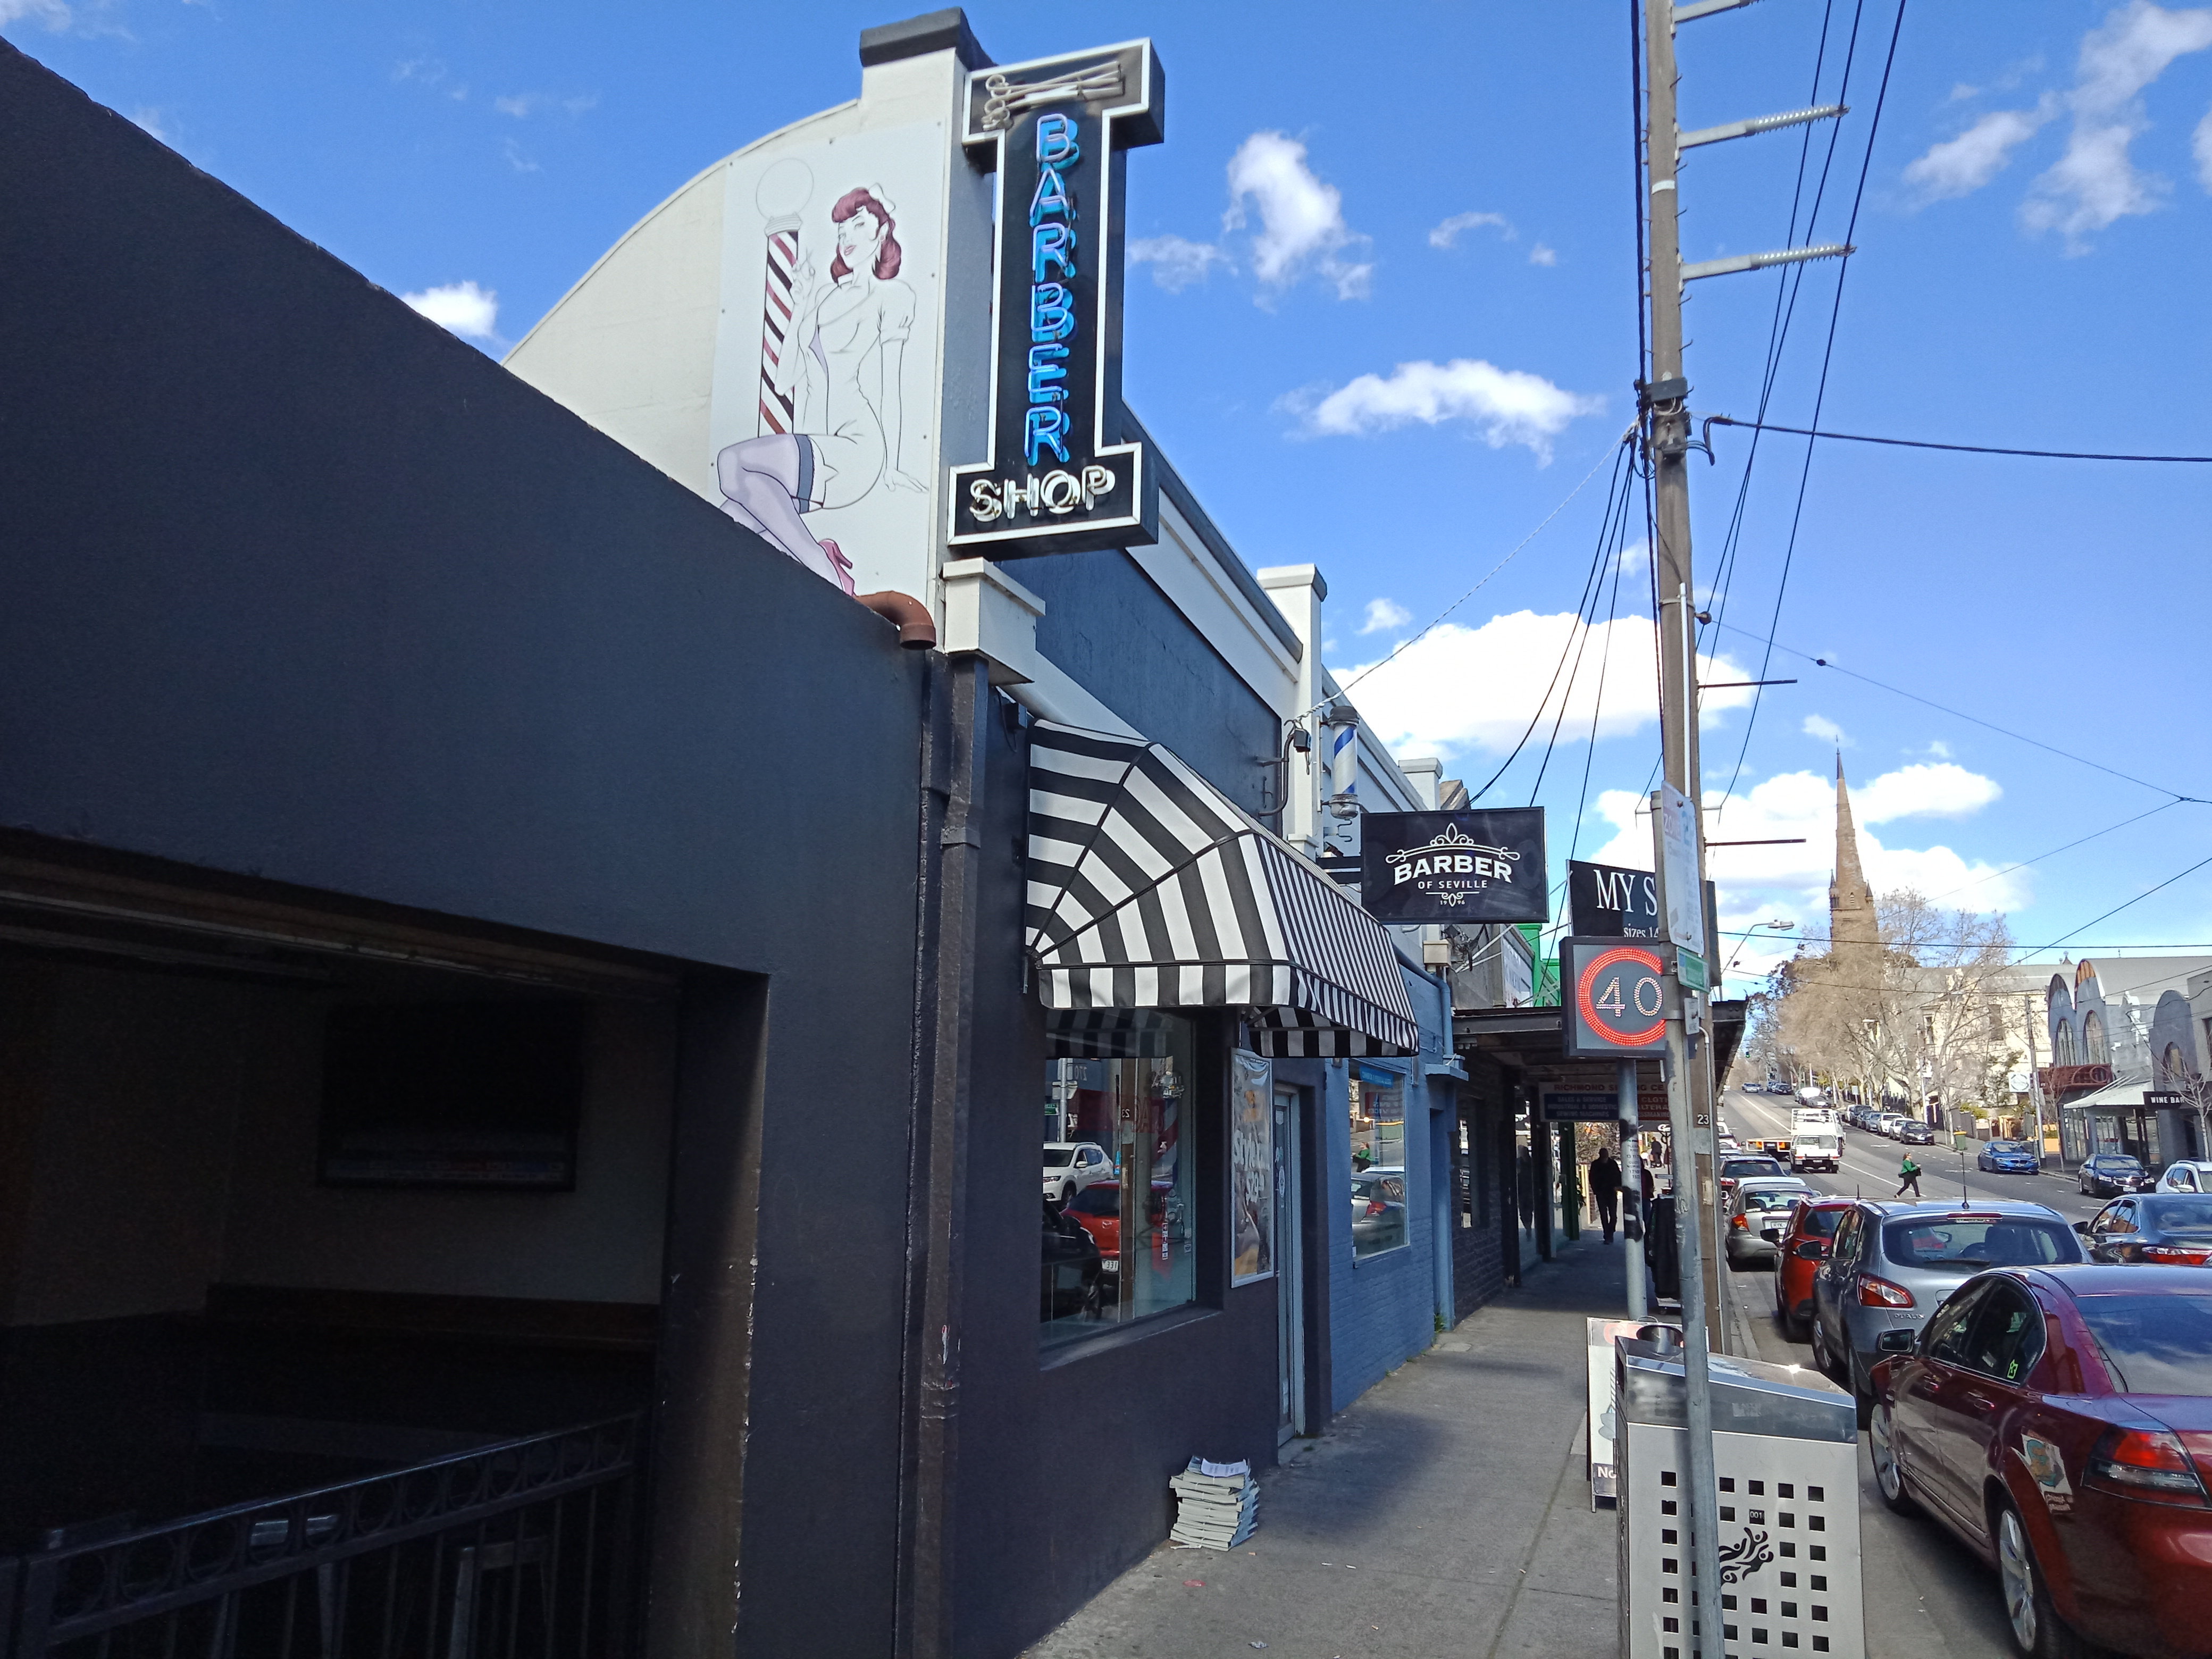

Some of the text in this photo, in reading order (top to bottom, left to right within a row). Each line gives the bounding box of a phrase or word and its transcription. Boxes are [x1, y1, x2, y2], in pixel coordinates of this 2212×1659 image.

[1024, 113, 1079, 466] BARBER
[969, 465, 1115, 522] SHOP
[1394, 854, 1513, 885] BARBER
[1418, 880, 1488, 889] OF SEVILLE
[1593, 869, 1636, 913] MY
[1623, 923, 1660, 938] sizes 14
[1596, 977, 1663, 1017] 40
[1697, 1113, 1710, 1125] 23
